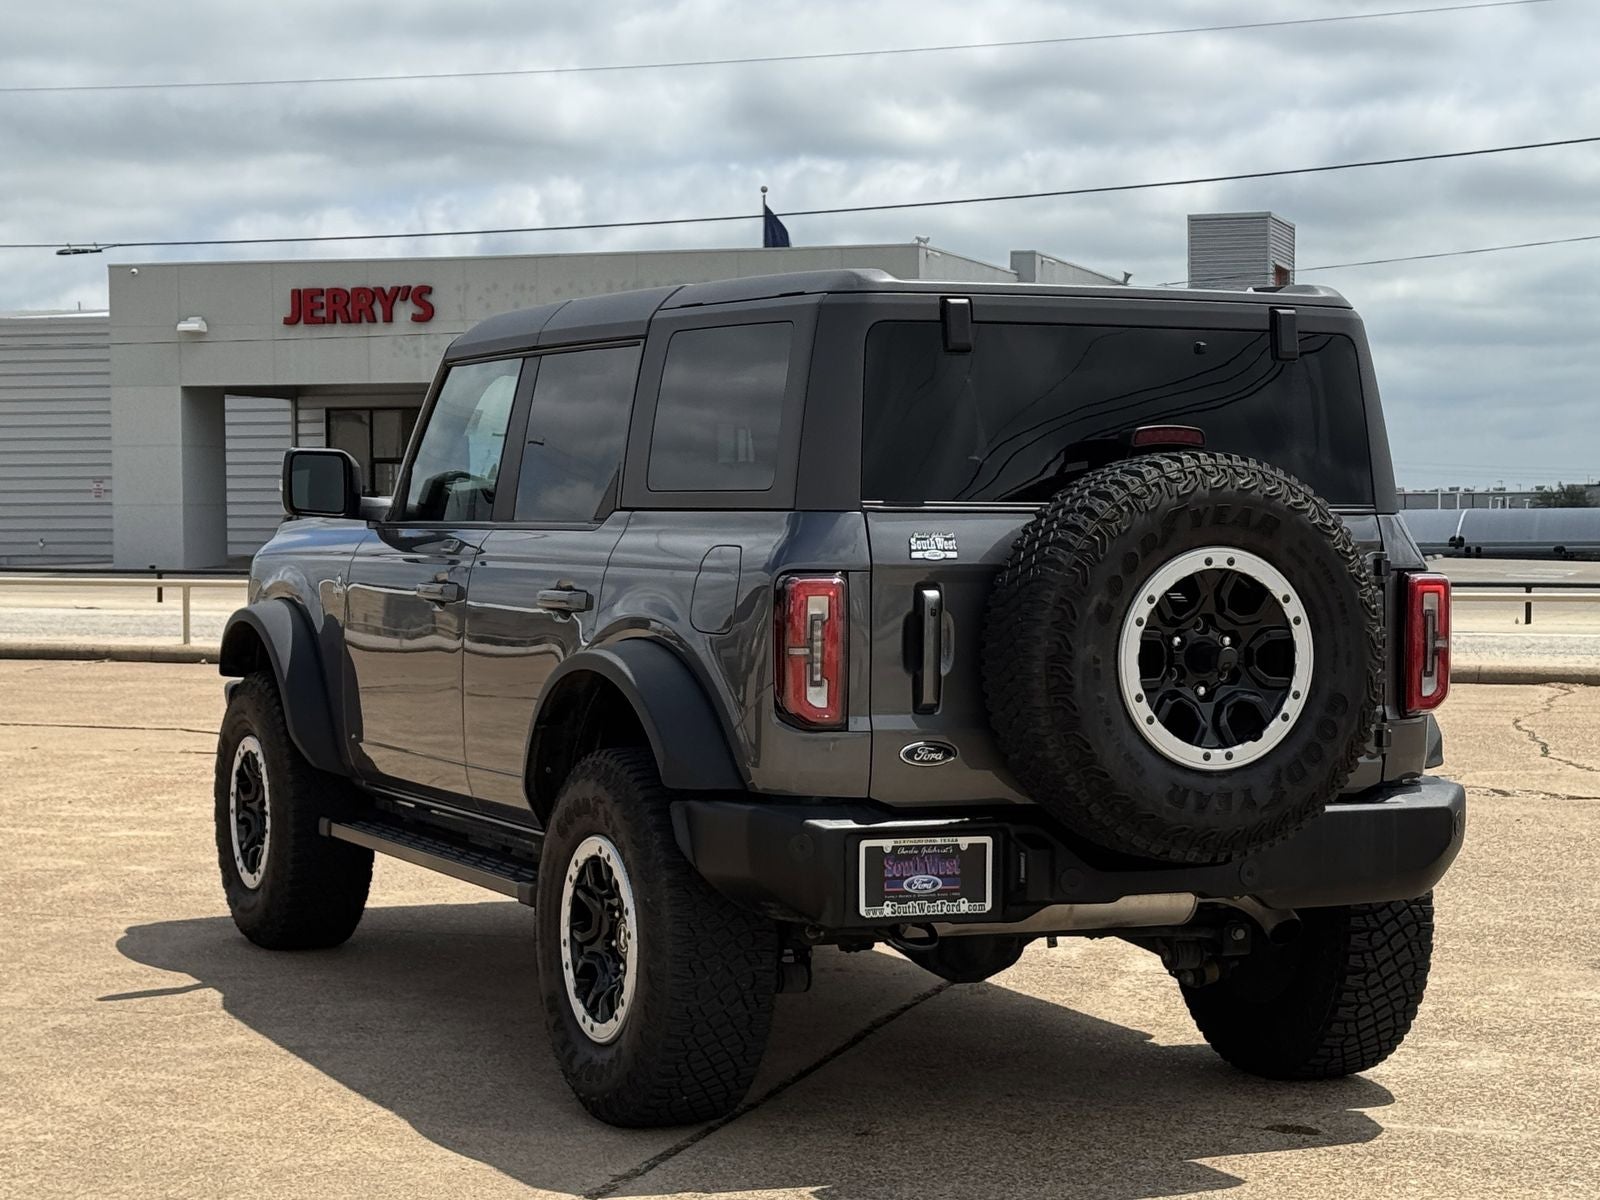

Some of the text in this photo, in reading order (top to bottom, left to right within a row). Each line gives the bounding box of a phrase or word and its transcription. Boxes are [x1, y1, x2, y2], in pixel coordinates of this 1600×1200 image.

[283, 285, 435, 325] JERRY'S
[914, 746, 944, 760] Ford
[884, 854, 960, 877] SouthWest
[911, 878, 934, 890] Ford
